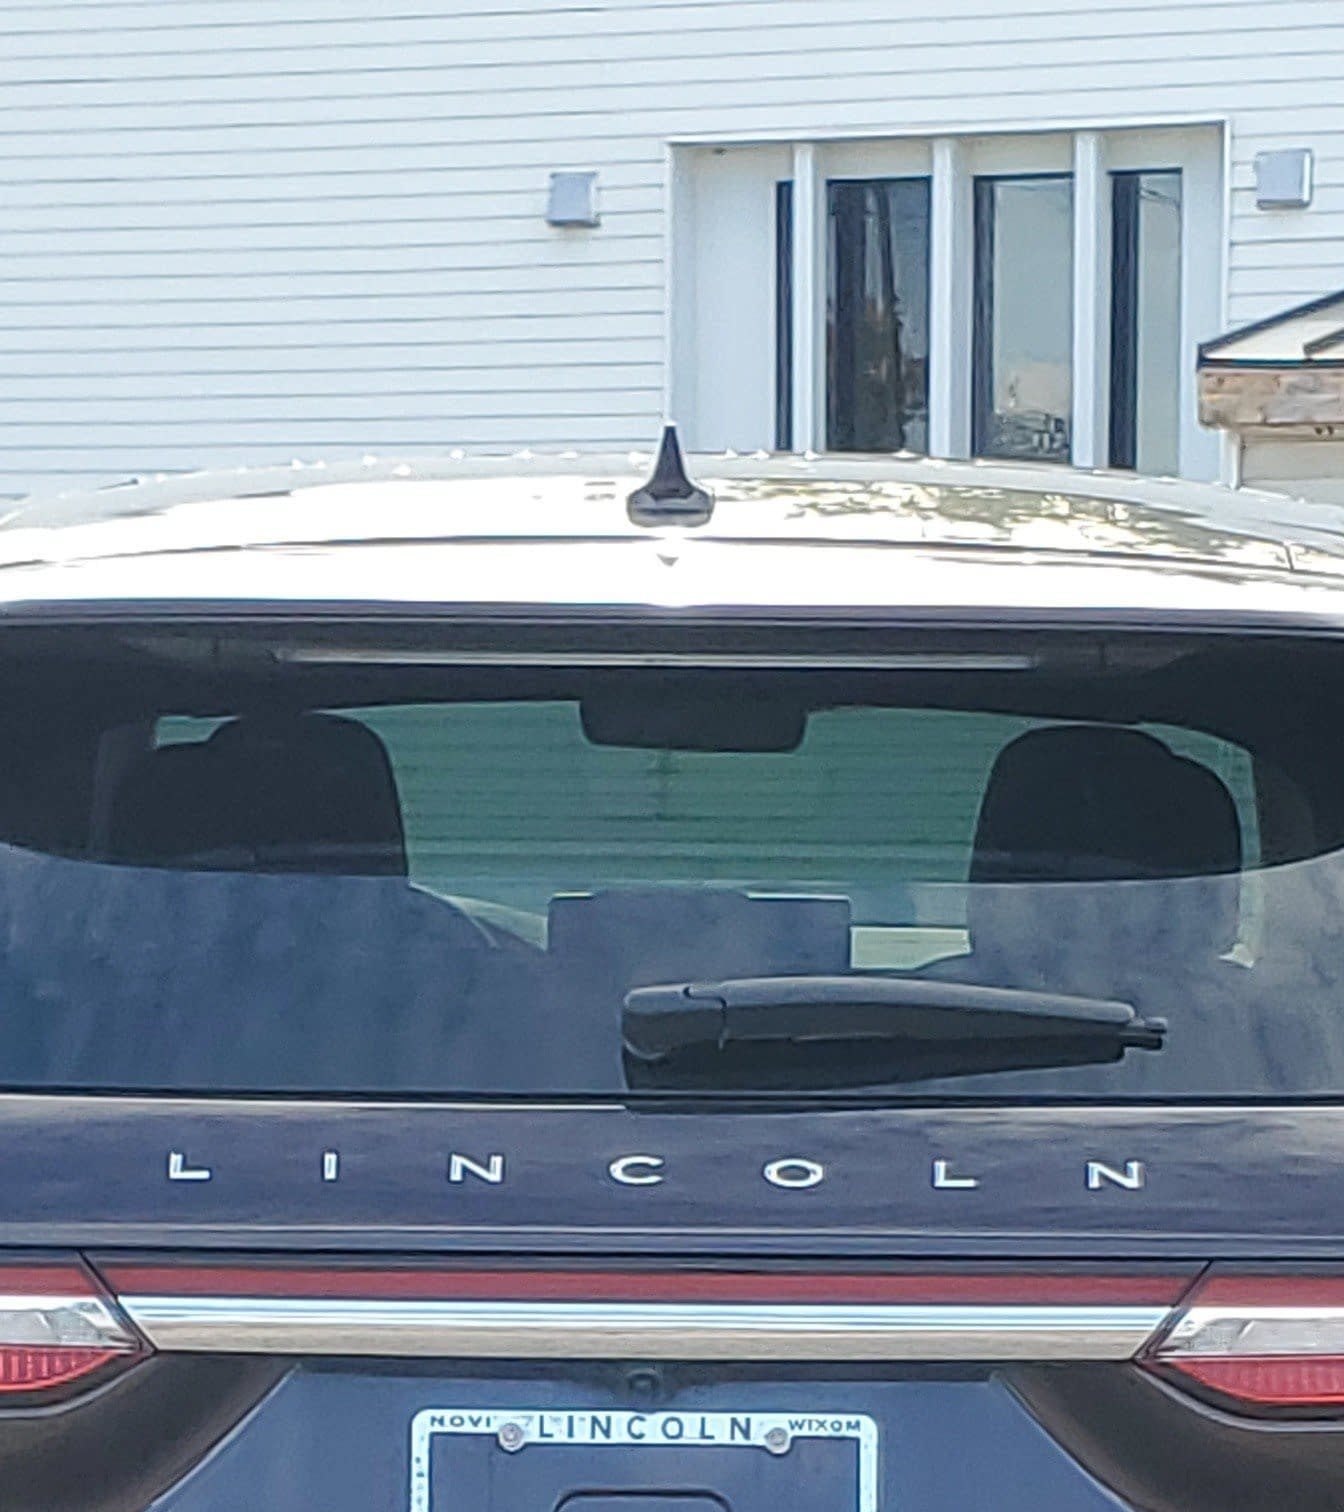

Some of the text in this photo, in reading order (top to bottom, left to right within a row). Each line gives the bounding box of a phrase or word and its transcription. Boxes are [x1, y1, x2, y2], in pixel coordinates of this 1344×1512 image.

[168, 1151, 1144, 1189] LINCOLN
[430, 1414, 862, 1441] NOVI LINCOLN WIXOM
